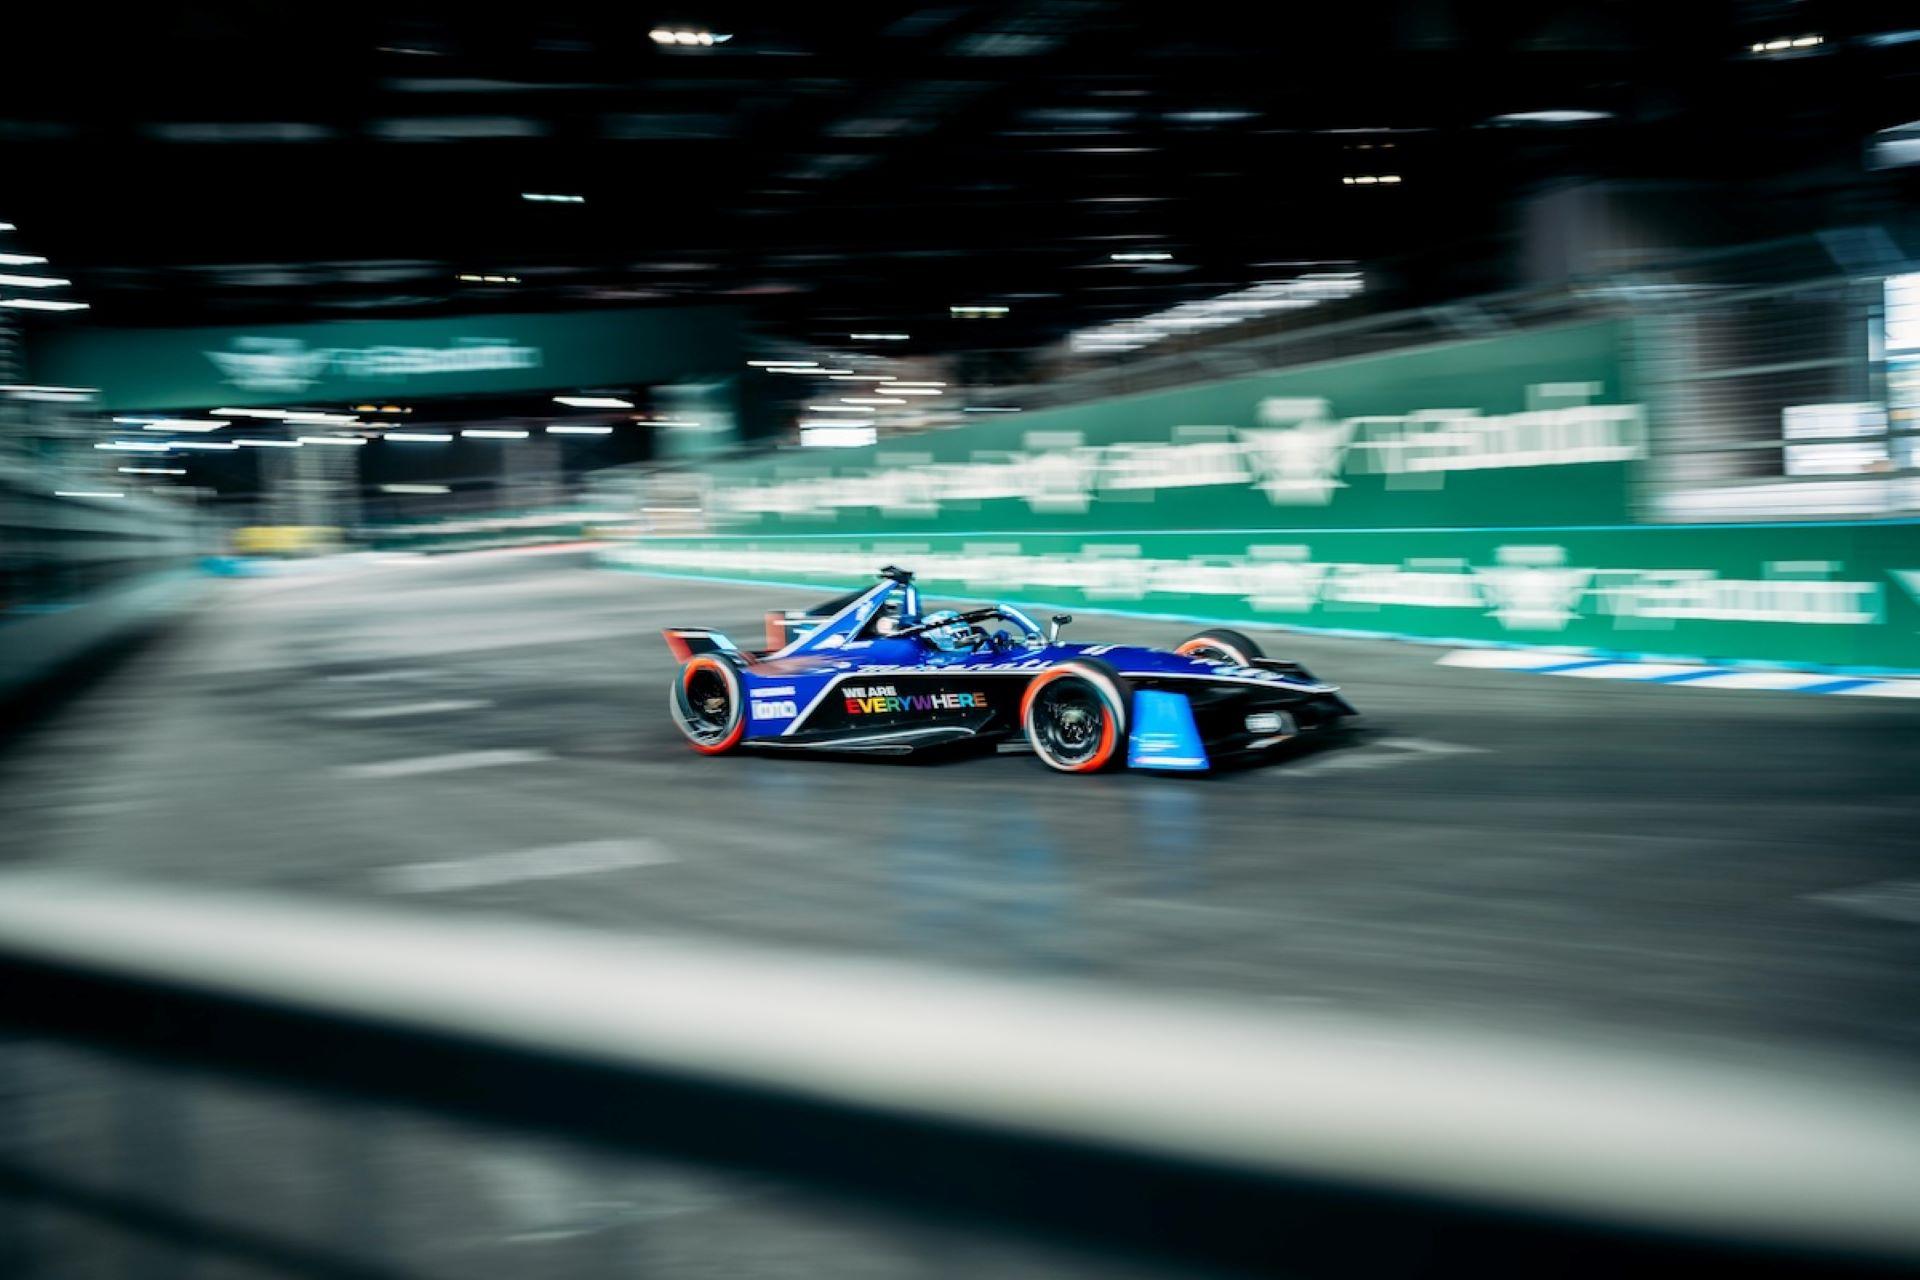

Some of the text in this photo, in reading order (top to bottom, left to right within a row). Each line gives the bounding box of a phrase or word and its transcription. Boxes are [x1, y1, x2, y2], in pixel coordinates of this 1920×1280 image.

[842, 685, 897, 698] WE ARE
[844, 692, 988, 714] EVERYWHERE
